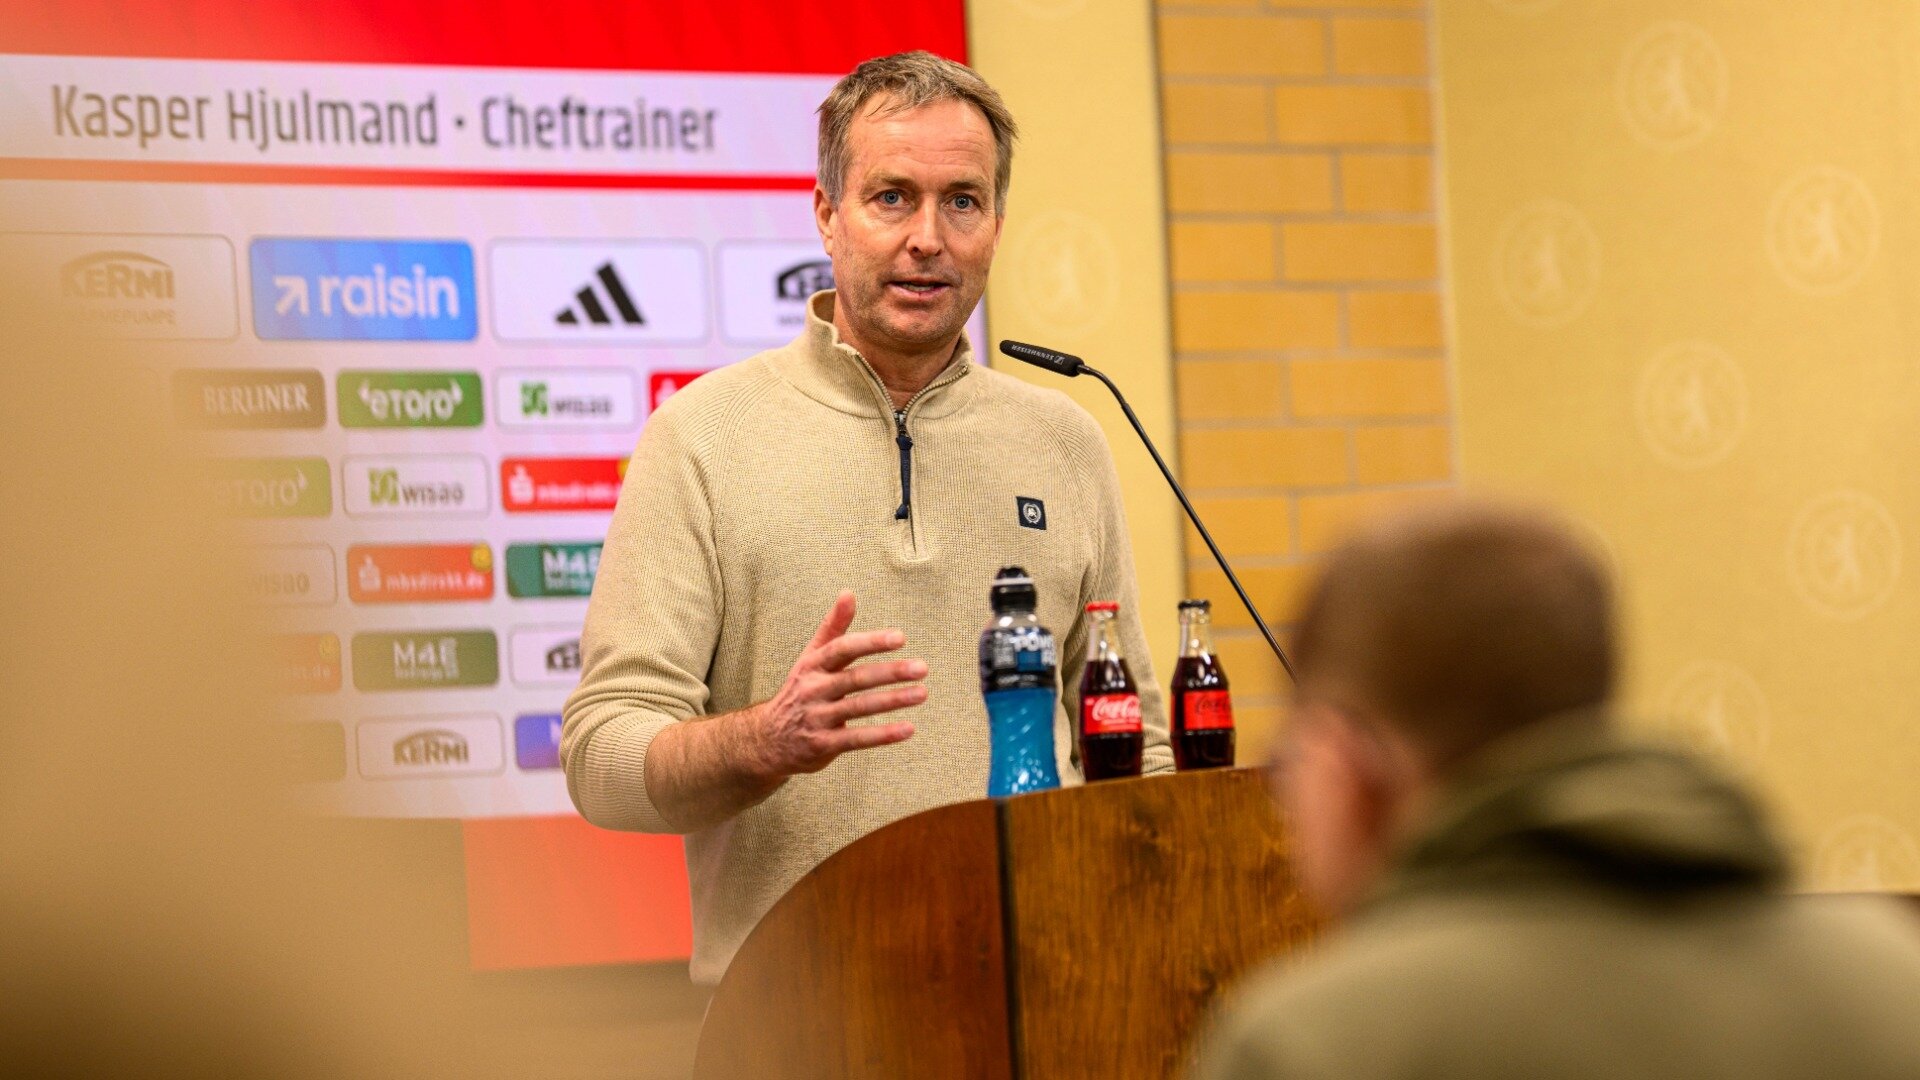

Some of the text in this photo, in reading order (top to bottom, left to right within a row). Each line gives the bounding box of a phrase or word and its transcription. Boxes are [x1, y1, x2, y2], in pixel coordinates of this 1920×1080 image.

[50, 84, 717, 152] Kasper Hjulmand Cheftrainer
[319, 263, 460, 319] raisin
[202, 383, 311, 415] BERLINER
